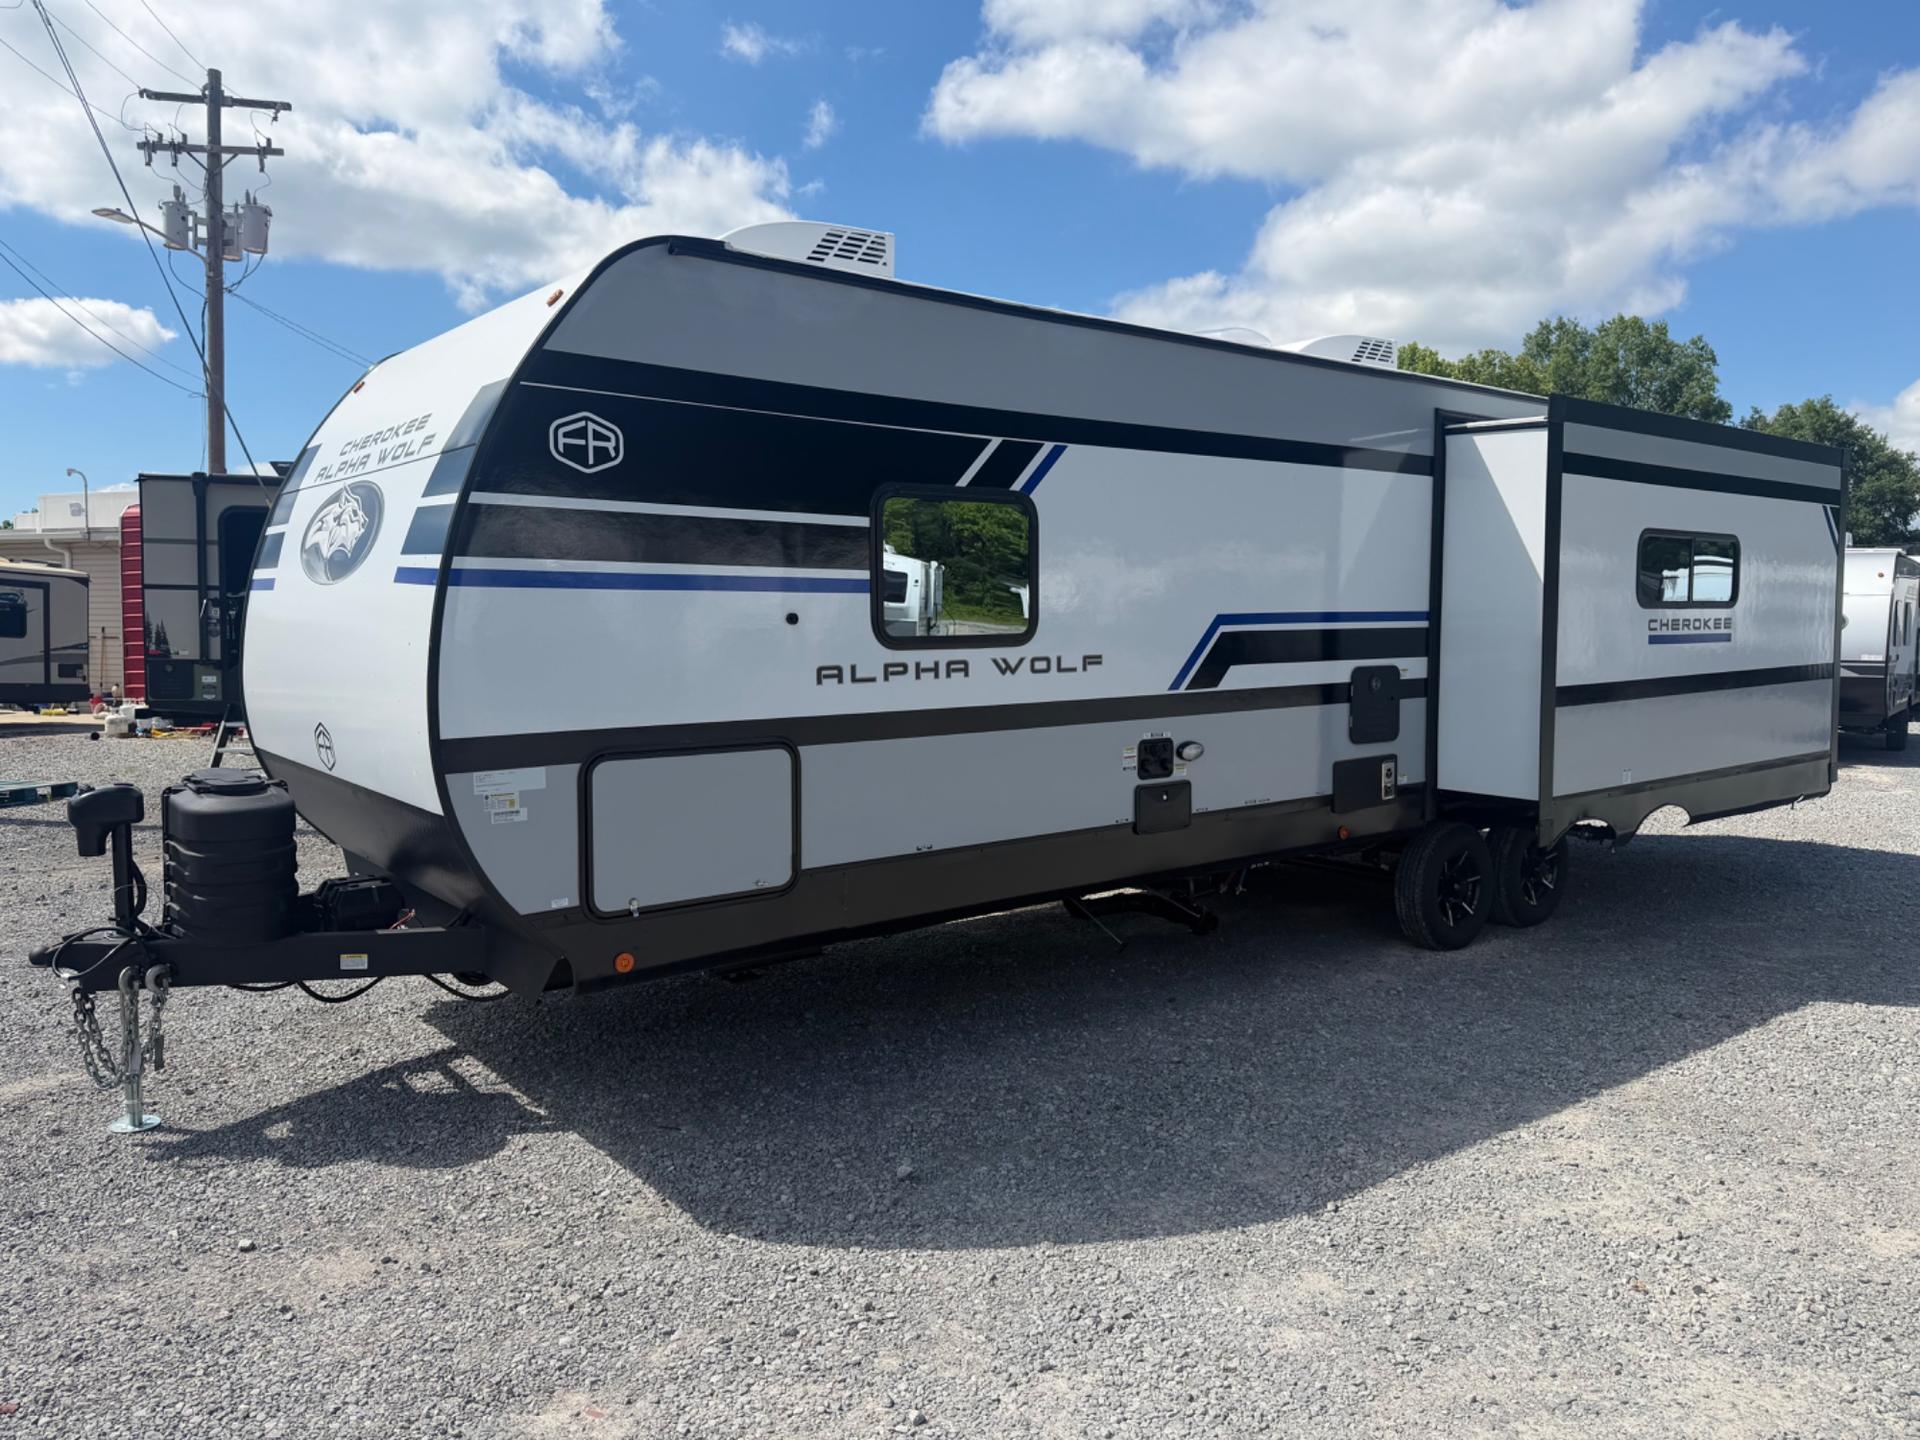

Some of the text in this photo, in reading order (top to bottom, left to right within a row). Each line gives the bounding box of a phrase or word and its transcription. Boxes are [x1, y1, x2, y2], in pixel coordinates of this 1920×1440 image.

[339, 413, 432, 456] CHEROKEE
[557, 420, 616, 465] FR
[315, 433, 436, 481] ALPHA WOLF
[1648, 618, 1732, 631] CHEROKEE
[816, 654, 1103, 685] ALPHA WOLF
